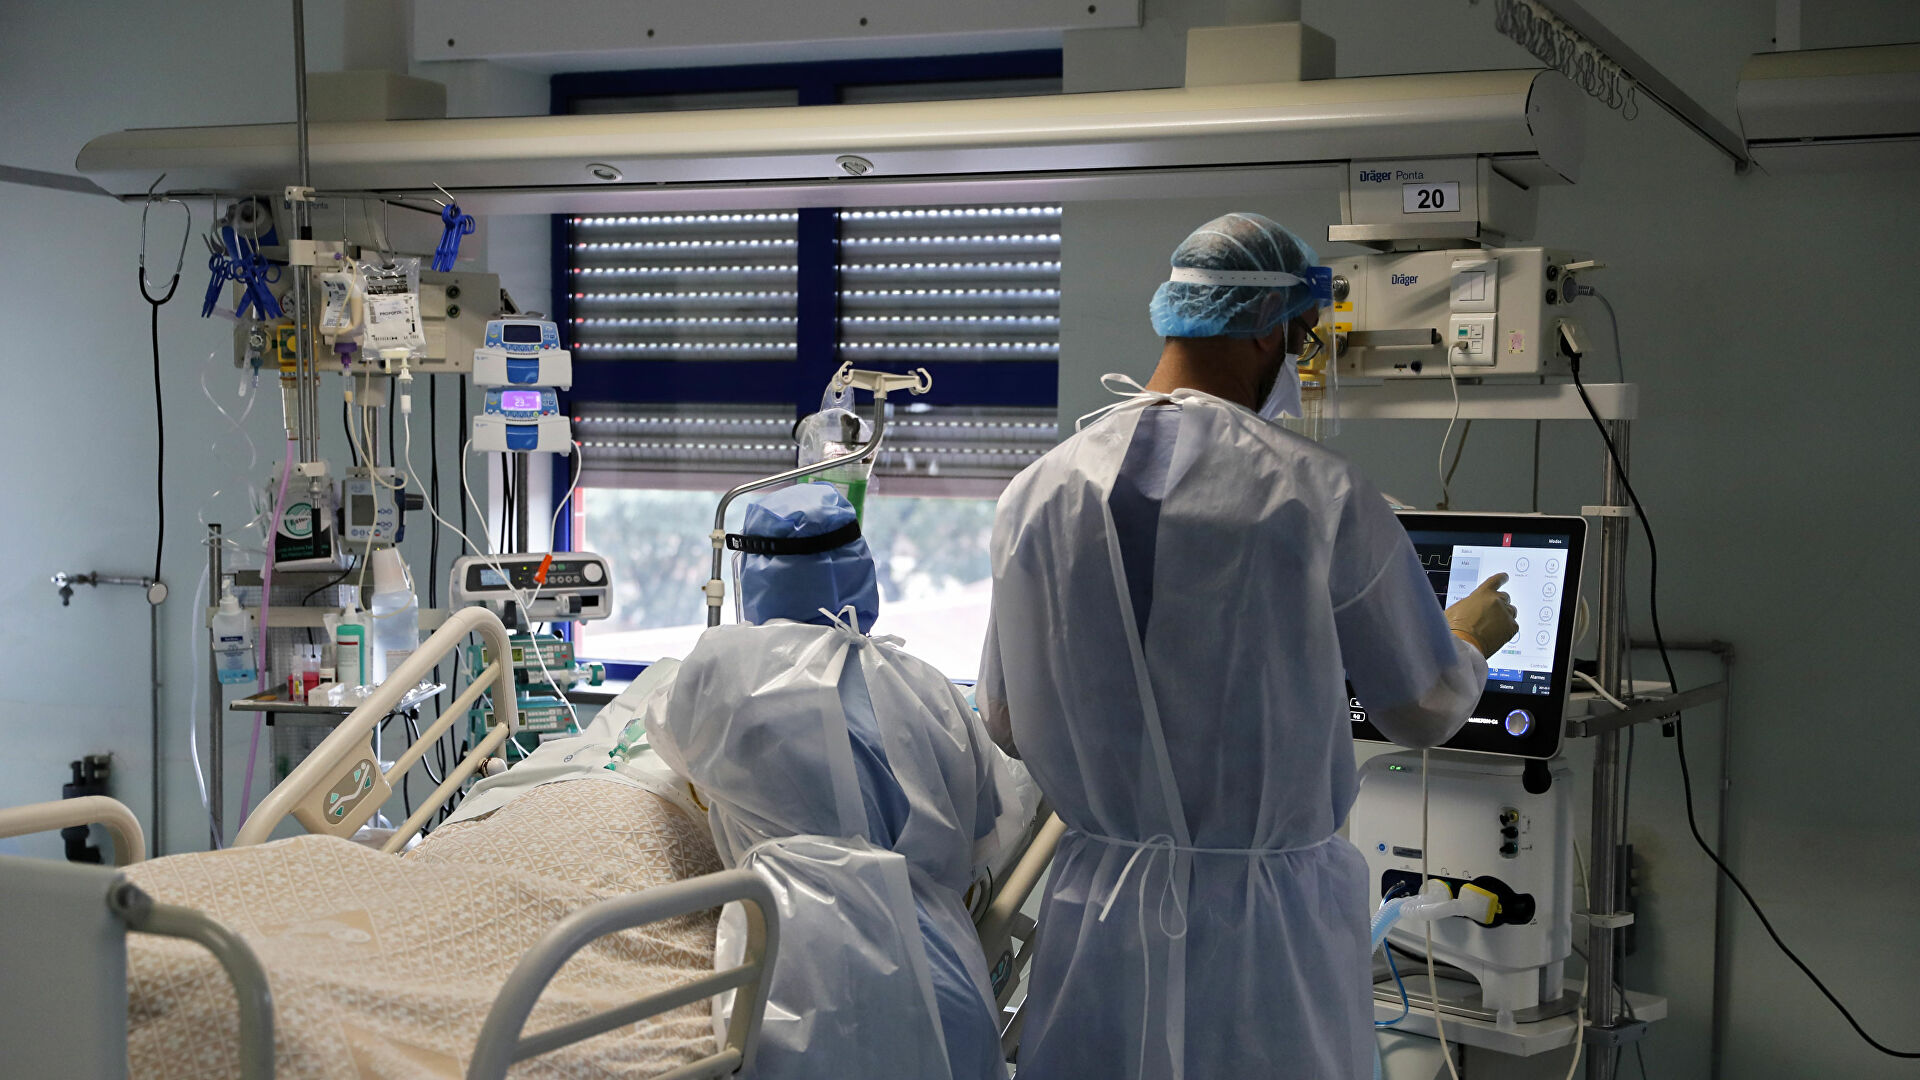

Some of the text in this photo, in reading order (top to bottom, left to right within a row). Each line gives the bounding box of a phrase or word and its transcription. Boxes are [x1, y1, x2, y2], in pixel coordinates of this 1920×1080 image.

[1360, 170, 1424, 182] Dräger Ponta
[1418, 189, 1444, 208] 20
[1392, 273, 1418, 286] Dräger
